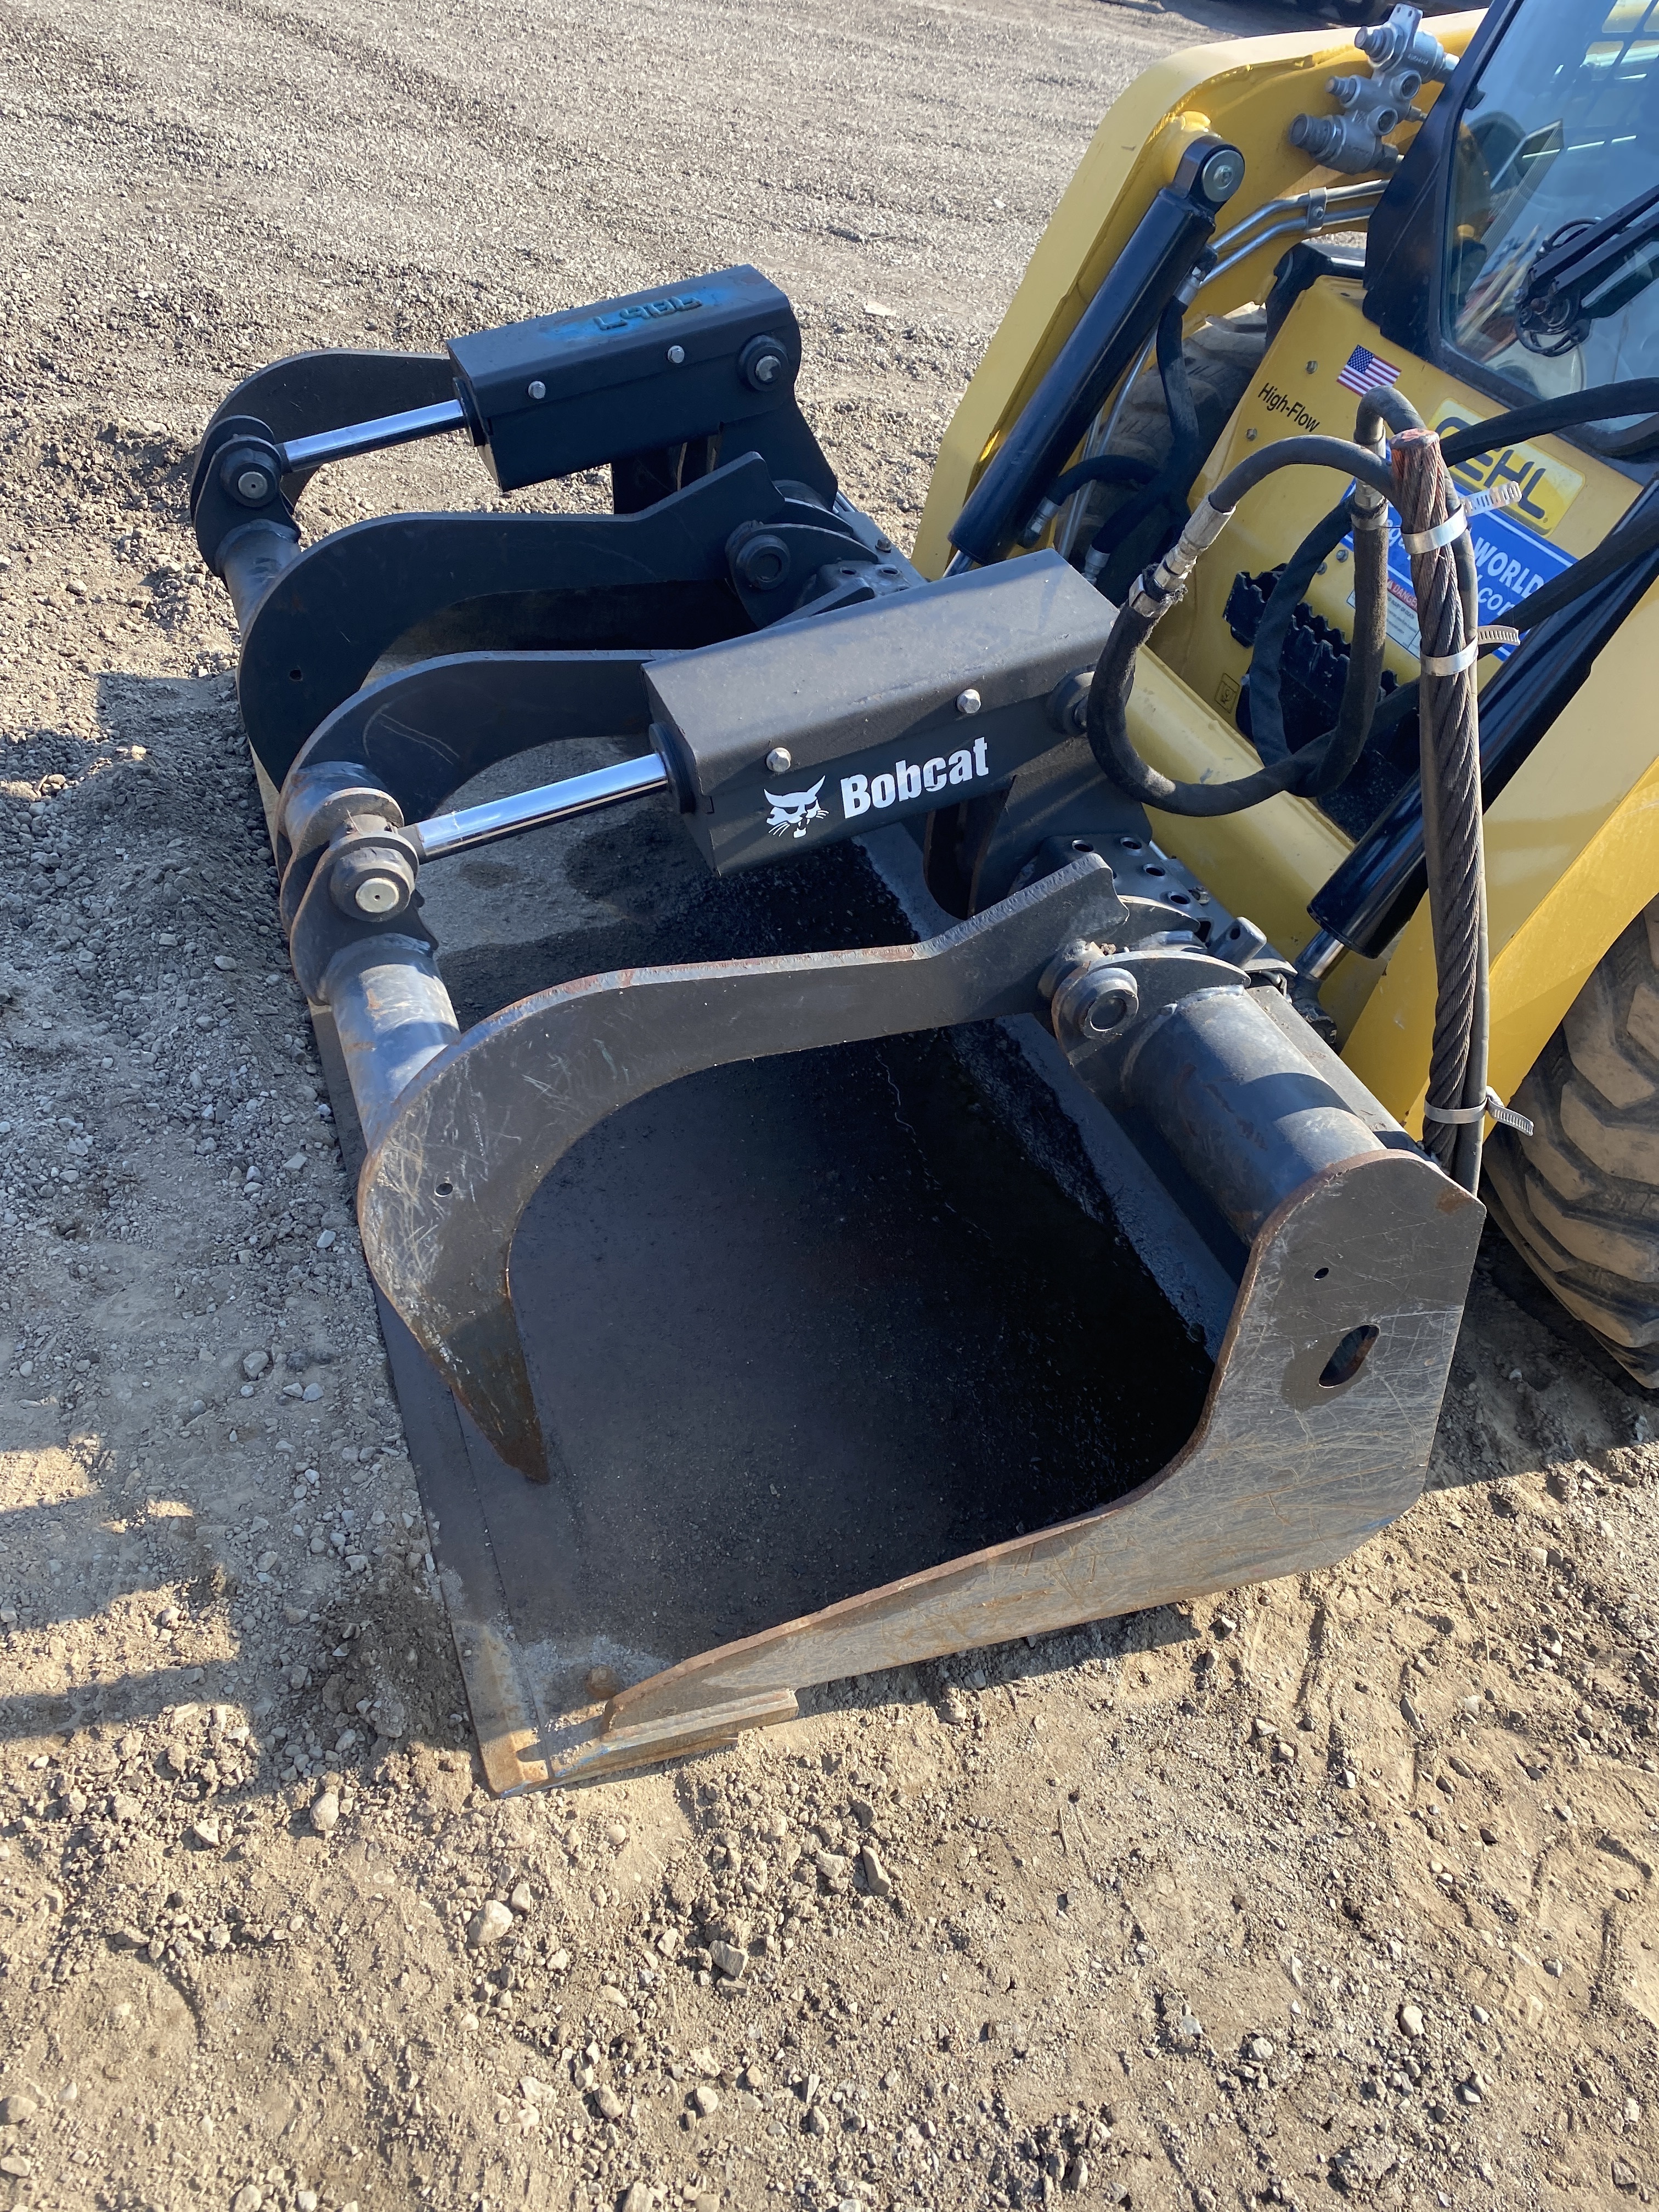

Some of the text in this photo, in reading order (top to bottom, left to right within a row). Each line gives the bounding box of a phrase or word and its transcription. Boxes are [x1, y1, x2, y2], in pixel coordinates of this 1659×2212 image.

[1257, 382, 1321, 432] High-Flow
[1392, 584, 1417, 608] DANGE
[1474, 537, 1544, 599] WORLD
[840, 736, 989, 819] Bobcat
